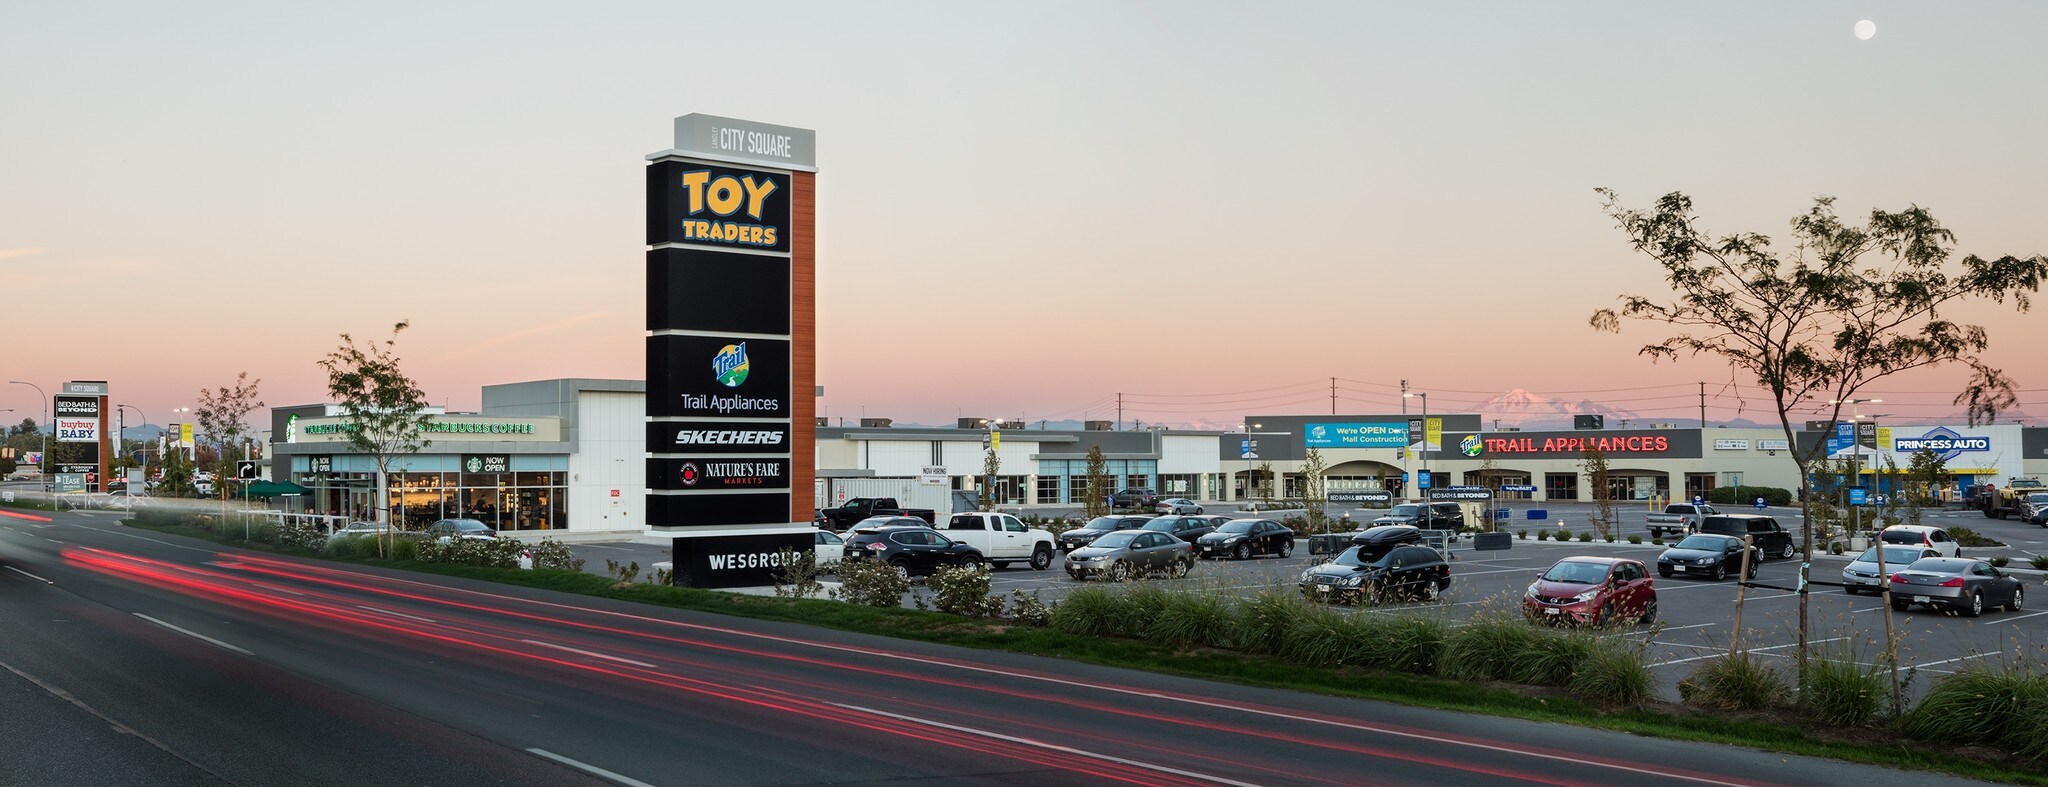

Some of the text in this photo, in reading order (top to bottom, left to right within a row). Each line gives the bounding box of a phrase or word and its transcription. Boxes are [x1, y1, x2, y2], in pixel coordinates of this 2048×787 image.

[711, 126, 719, 149] LANGLEY
[720, 127, 791, 158] CITY SQUARE
[683, 170, 777, 220] TOY
[683, 219, 777, 246] TRADERS
[713, 341, 747, 381] Trail
[681, 394, 779, 414] Trail Appliances
[61, 420, 95, 429] buybuy
[417, 422, 536, 434] STARBUCKS COFFEE
[1336, 427, 1358, 435] We're
[1360, 426, 1386, 434] OPEN
[61, 430, 95, 438] BABY
[675, 430, 784, 445] SKECHERS
[1360, 435, 1408, 443] Construction
[1460, 433, 1482, 454] Trail
[1485, 436, 1669, 453] TRAIL APPLIANCES
[1897, 439, 1987, 449] PRINCESS AUTO
[486, 457, 505, 465] NOW
[485, 464, 505, 472] OPEN
[705, 462, 754, 477] NATURE'S
[755, 462, 780, 477] FARE
[922, 467, 947, 475] NOW HIRING
[724, 477, 763, 485] MARKETS
